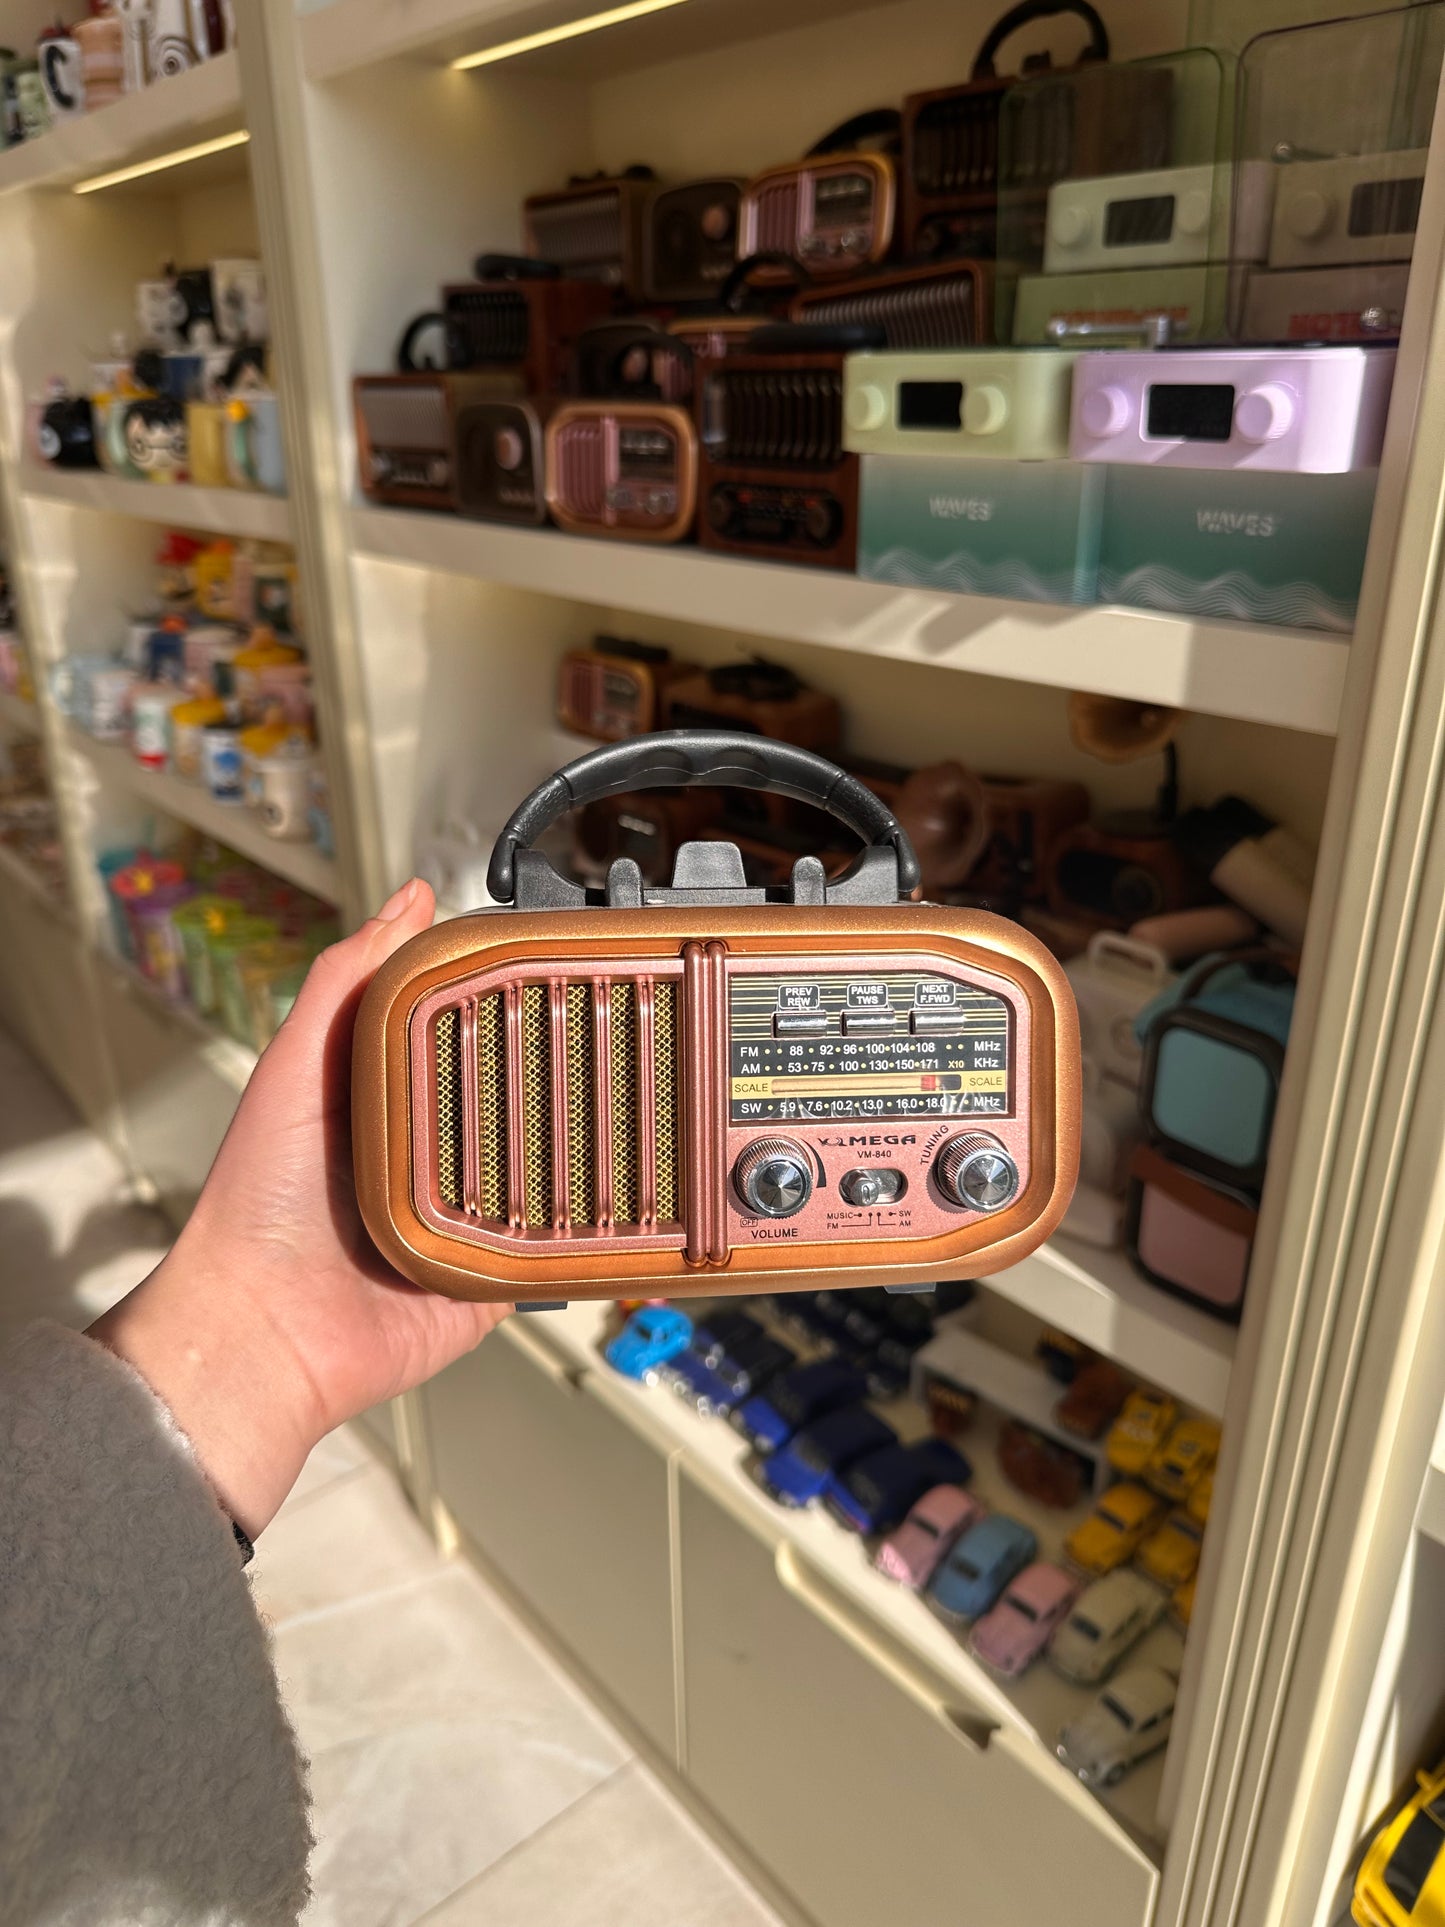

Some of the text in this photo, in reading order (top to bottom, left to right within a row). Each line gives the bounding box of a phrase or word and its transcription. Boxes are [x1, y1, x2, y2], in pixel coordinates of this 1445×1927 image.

[929, 497, 992, 521] WAVES
[1196, 509, 1275, 537] WAVES
[785, 987, 813, 996] PREV
[851, 985, 884, 995] PAUSE
[922, 984, 949, 993] NEXT
[787, 997, 811, 1006] REW
[856, 995, 879, 1005] TWS
[920, 994, 950, 1004] F.FWD
[740, 1040, 1001, 1057] FM 88 92 96 100 104 108 MHz
[741, 1057, 999, 1074] AM 53 75 100 130 150 171 X10 KHz
[969, 1076, 1003, 1087] SCALE
[734, 1082, 769, 1093] SCALE
[741, 1102, 762, 1114] SW
[780, 1101, 796, 1112] 5.9
[806, 1101, 823, 1112] 7.6
[832, 1100, 853, 1111] 10.2
[862, 1099, 883, 1110] 13.0
[896, 1098, 918, 1109] 16.0
[974, 1096, 1001, 1107] MHz
[920, 1125, 949, 1165] TUNING
[857, 1150, 892, 1159] VM-840
[826, 1212, 854, 1220] MUSIC
[751, 1228, 799, 1239] VOLUME
